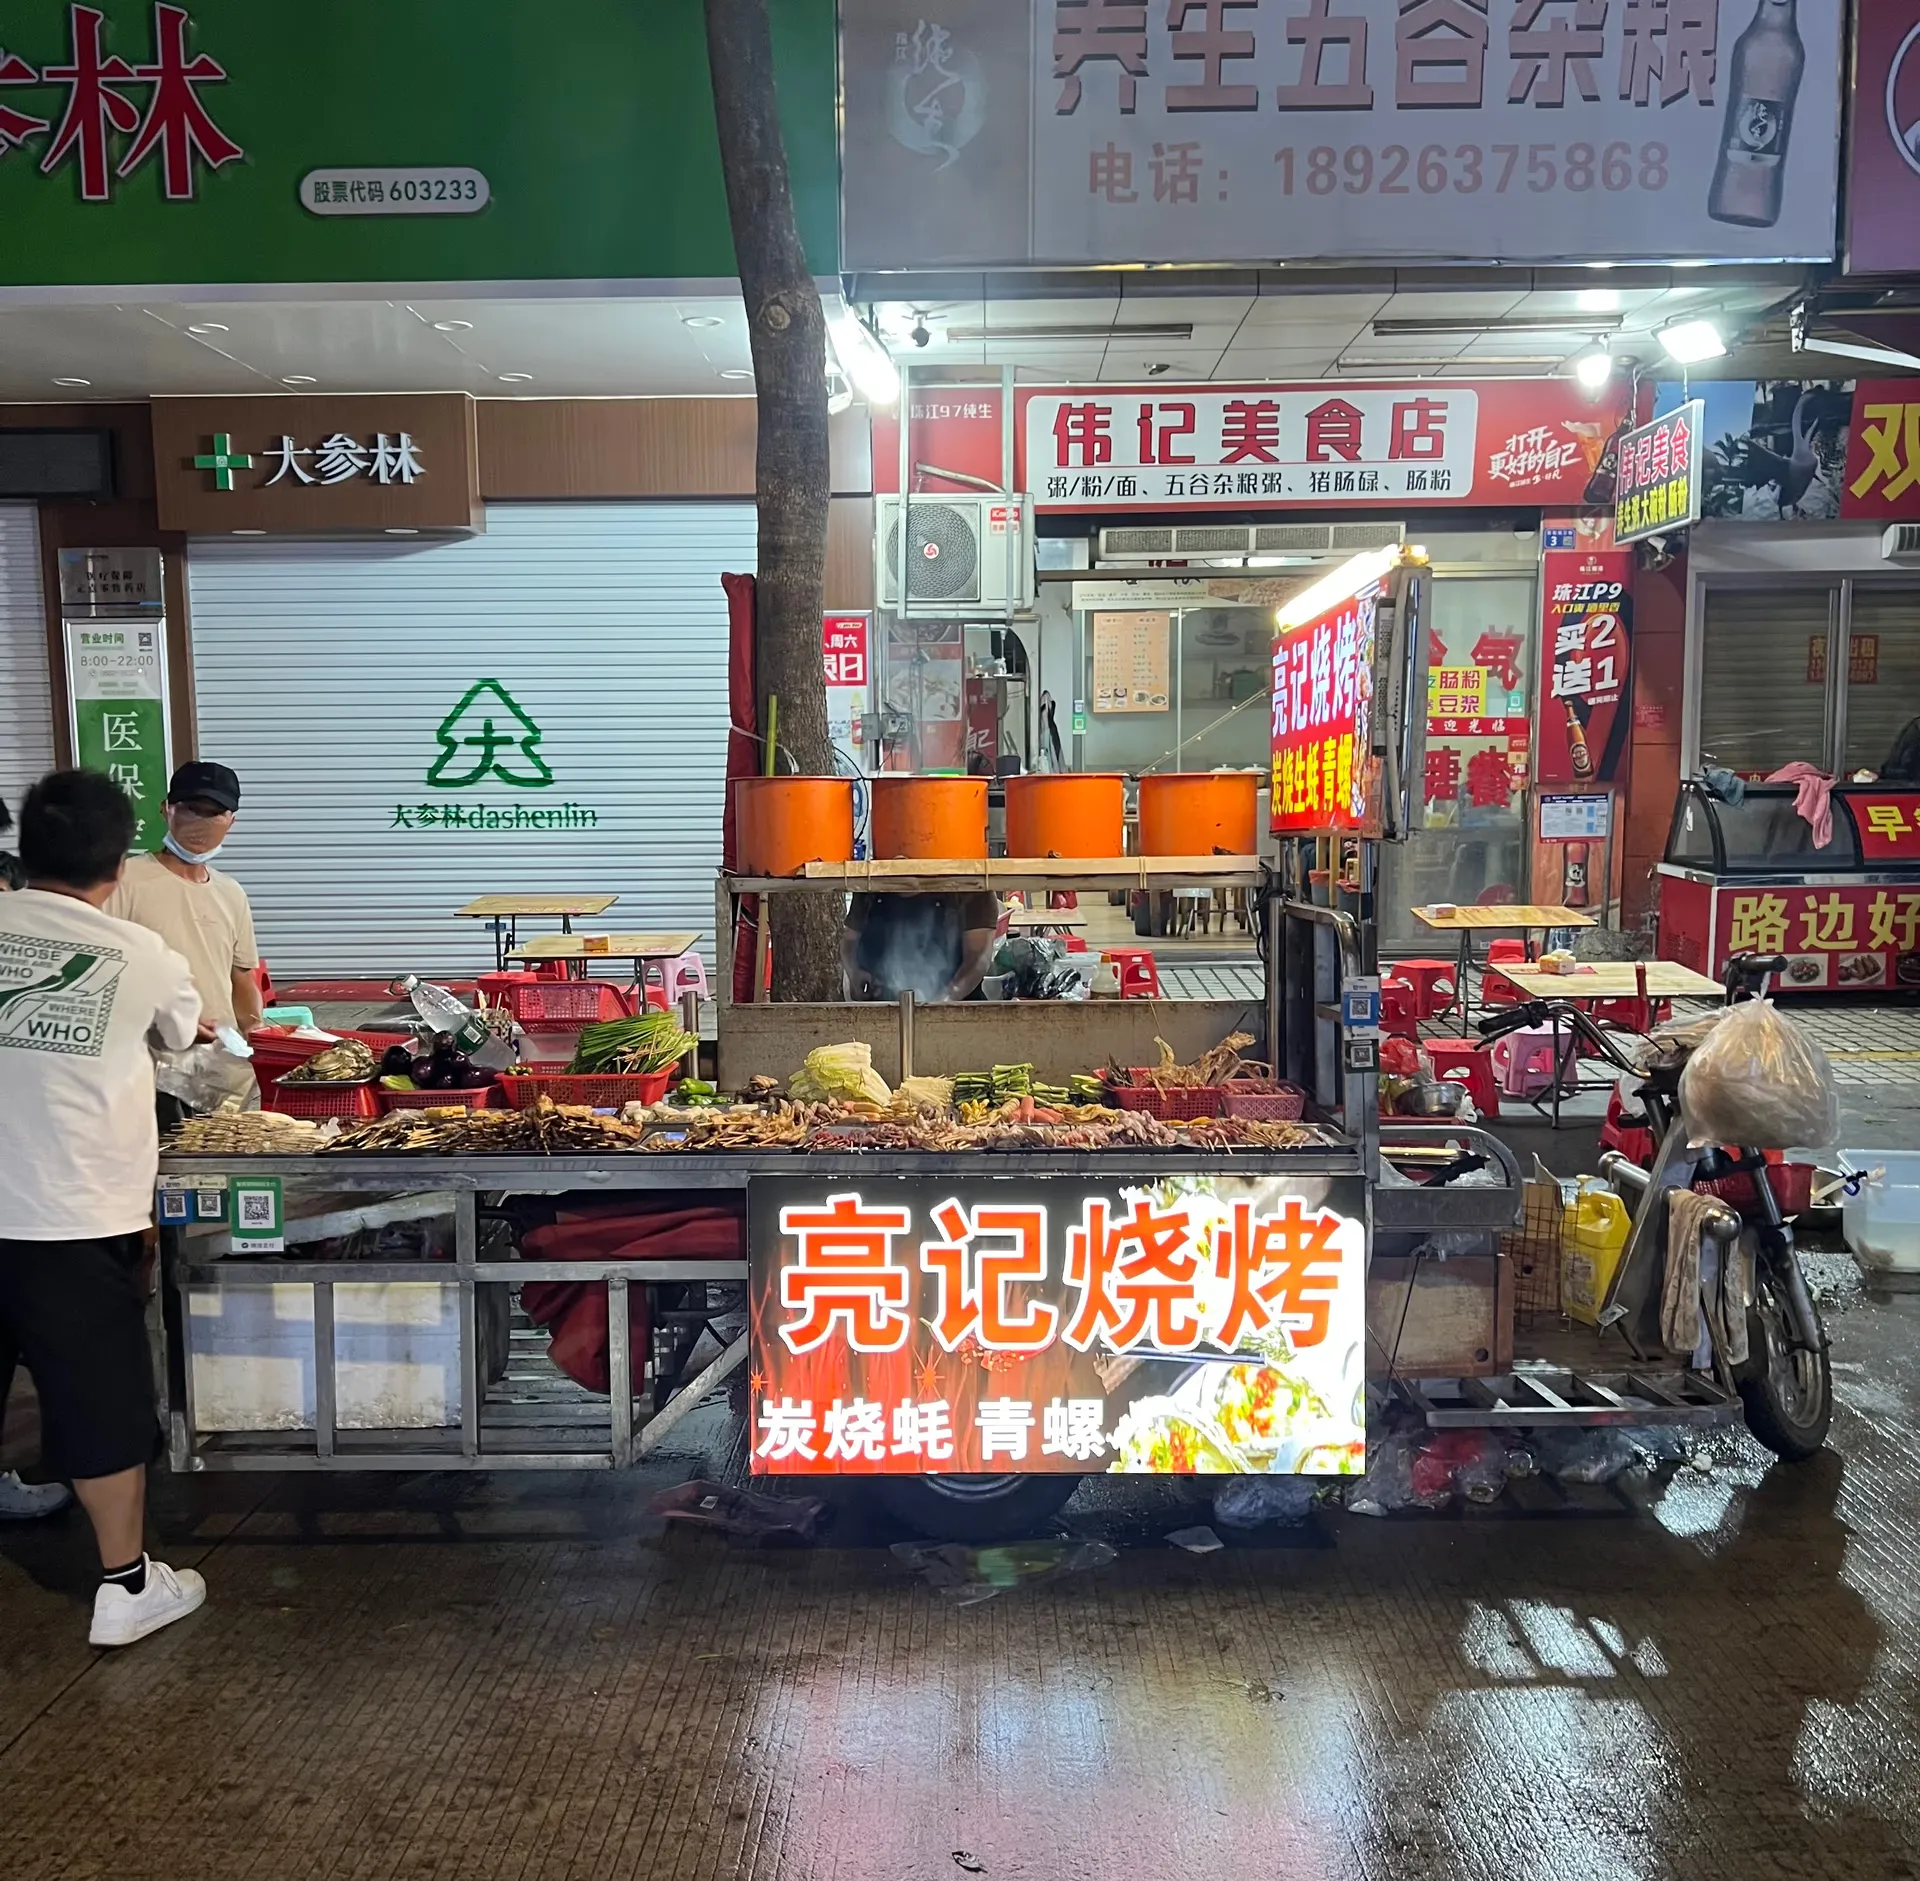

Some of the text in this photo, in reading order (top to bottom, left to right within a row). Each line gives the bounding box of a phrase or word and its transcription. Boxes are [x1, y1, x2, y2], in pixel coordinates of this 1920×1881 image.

[1052, 0, 1717, 116] 养生五谷杂粮
[0, 2, 244, 200] 林
[1052, 397, 1449, 467] 伟记美食店
[1505, 425, 1553, 452] 打开
[263, 433, 426, 486] 大参林
[1487, 439, 1582, 481] 更好的自己
[1550, 536, 1557, 546] 3
[1551, 582, 1623, 601] 珠江P9
[1554, 614, 1616, 655] 买2
[80, 655, 154, 667] 8:00-22:00
[1271, 612, 1357, 738] 亮记烧烤
[1551, 656, 1619, 698] 送1
[1867, 804, 1920, 842] 早
[1729, 891, 1920, 954] 路边好
[28, 1019, 91, 1042] WHO
[778, 1192, 1346, 1354] 亮记烧烤
[755, 1396, 1107, 1461] 炭烧蚝 青螺
